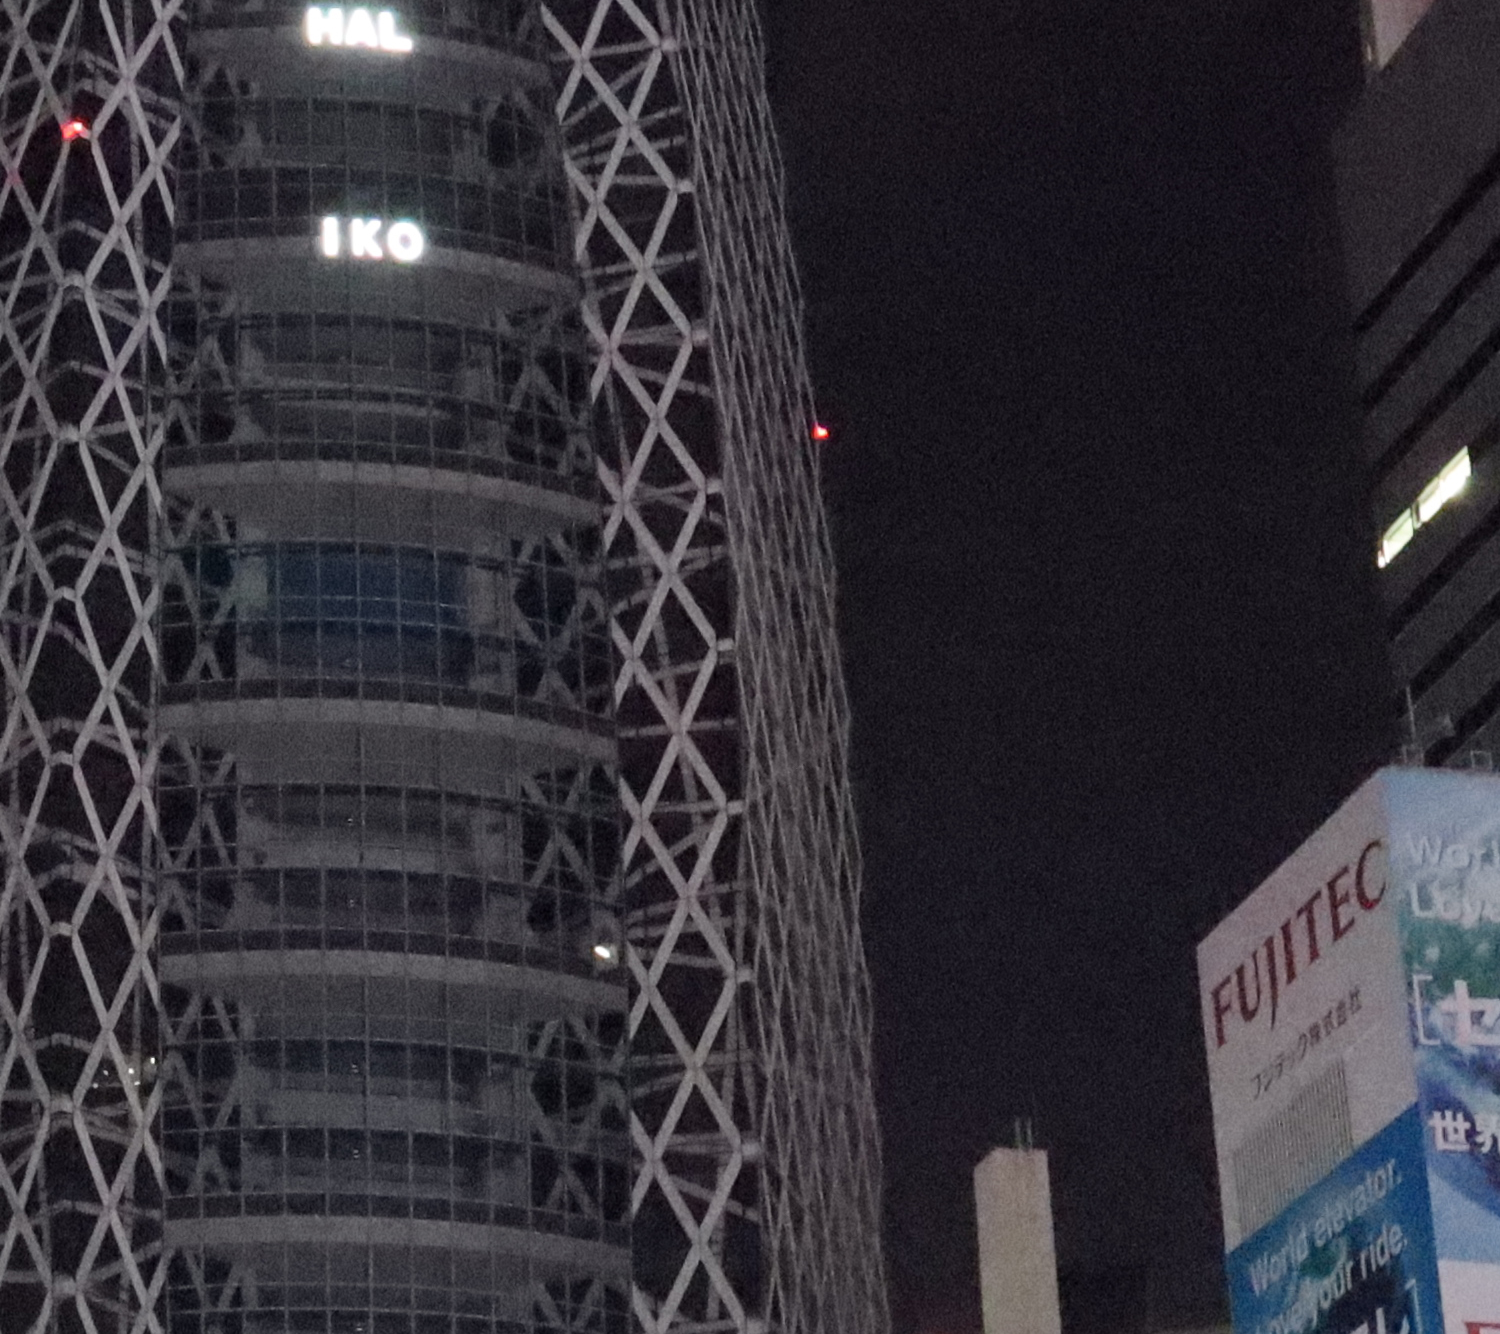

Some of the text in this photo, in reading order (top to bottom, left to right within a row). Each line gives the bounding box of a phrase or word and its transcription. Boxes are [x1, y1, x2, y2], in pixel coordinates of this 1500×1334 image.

[306, 6, 413, 52] HAL
[321, 216, 424, 262] IKO
[1211, 839, 1389, 1049] FUJITEC
[1248, 1225, 1309, 1297] World
[1303, 1260, 1355, 1328] your
